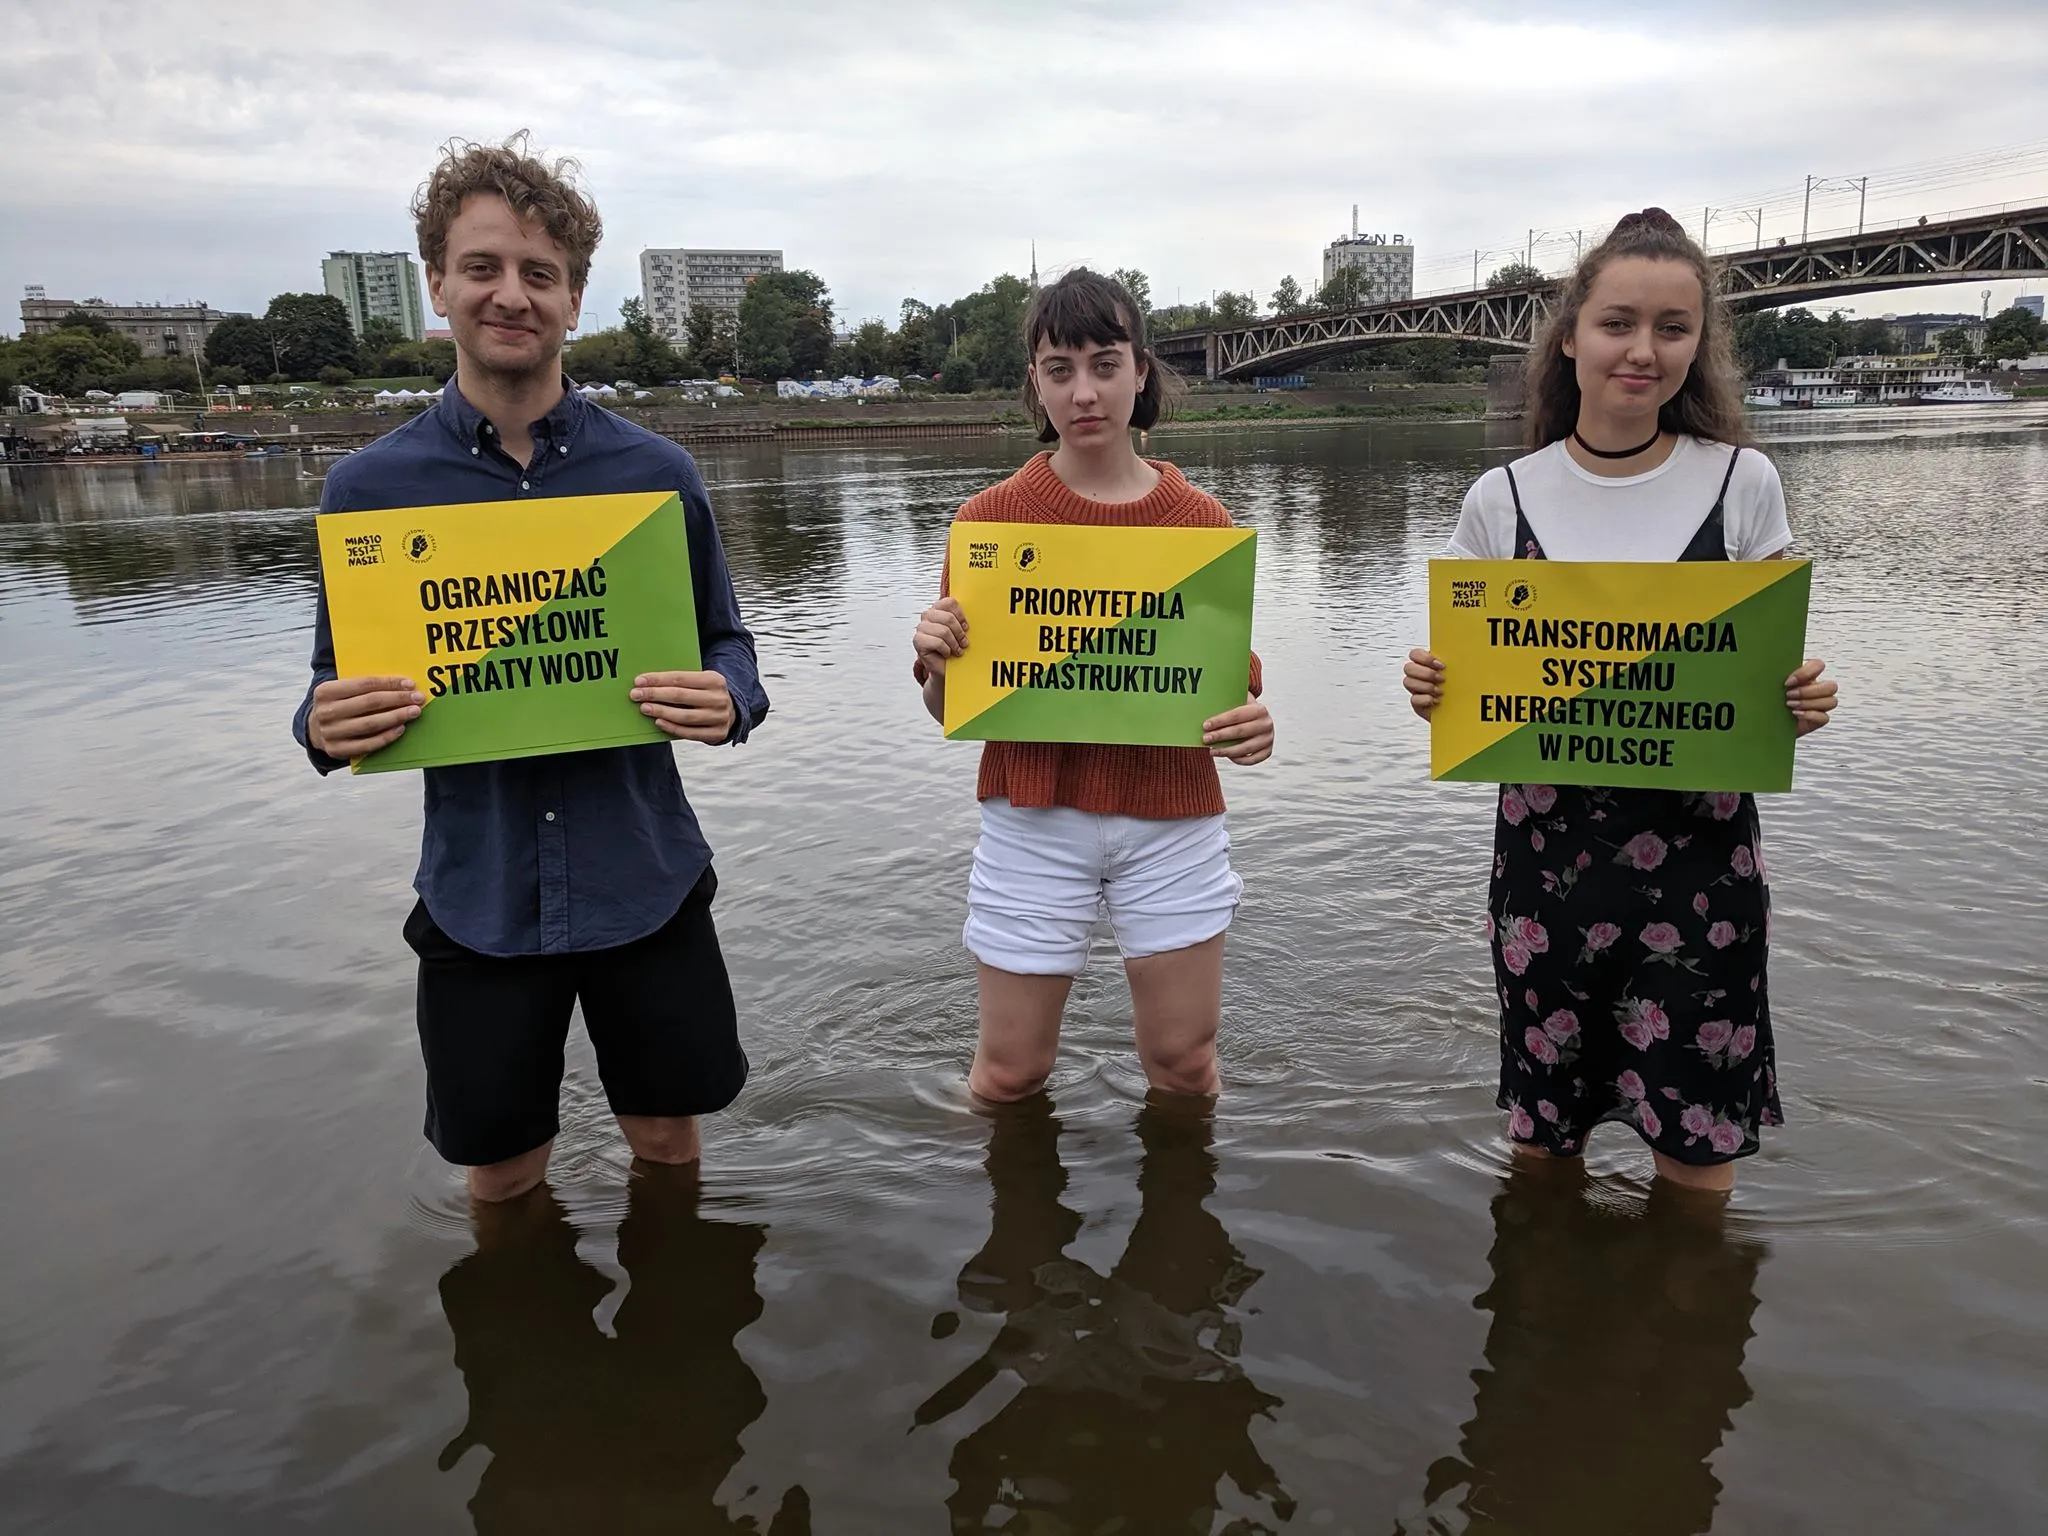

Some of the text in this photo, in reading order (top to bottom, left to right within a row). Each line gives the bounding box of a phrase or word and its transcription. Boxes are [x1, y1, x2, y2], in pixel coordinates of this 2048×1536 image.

[1358, 233, 1404, 245] ZNP
[345, 534, 382, 546] MIASTO
[970, 542, 999, 551] MIASTO
[346, 546, 369, 557] JEST
[348, 555, 379, 567] NASZE
[970, 552, 987, 560] JEST
[969, 560, 993, 569] NASZE
[419, 558, 607, 612] OGRANICZAĆ
[1452, 580, 1487, 590] MIASTO
[1453, 590, 1473, 599] JEST
[1009, 587, 1186, 620] PRIORYTET DLA
[1452, 599, 1481, 609] NASZE
[425, 607, 610, 656] PRZESYŁOWE
[1486, 617, 1738, 653] TRANSFORMACJA
[1038, 625, 1158, 661] BŁĘKITNEJ
[426, 648, 621, 698] STRATY WODY
[991, 660, 1204, 695] INFRASTRUKTURY
[1541, 657, 1676, 692] SYSTEMU
[1479, 694, 1737, 733] ENERGETYCZNEGO
[1538, 733, 1676, 768] W POLSCE
